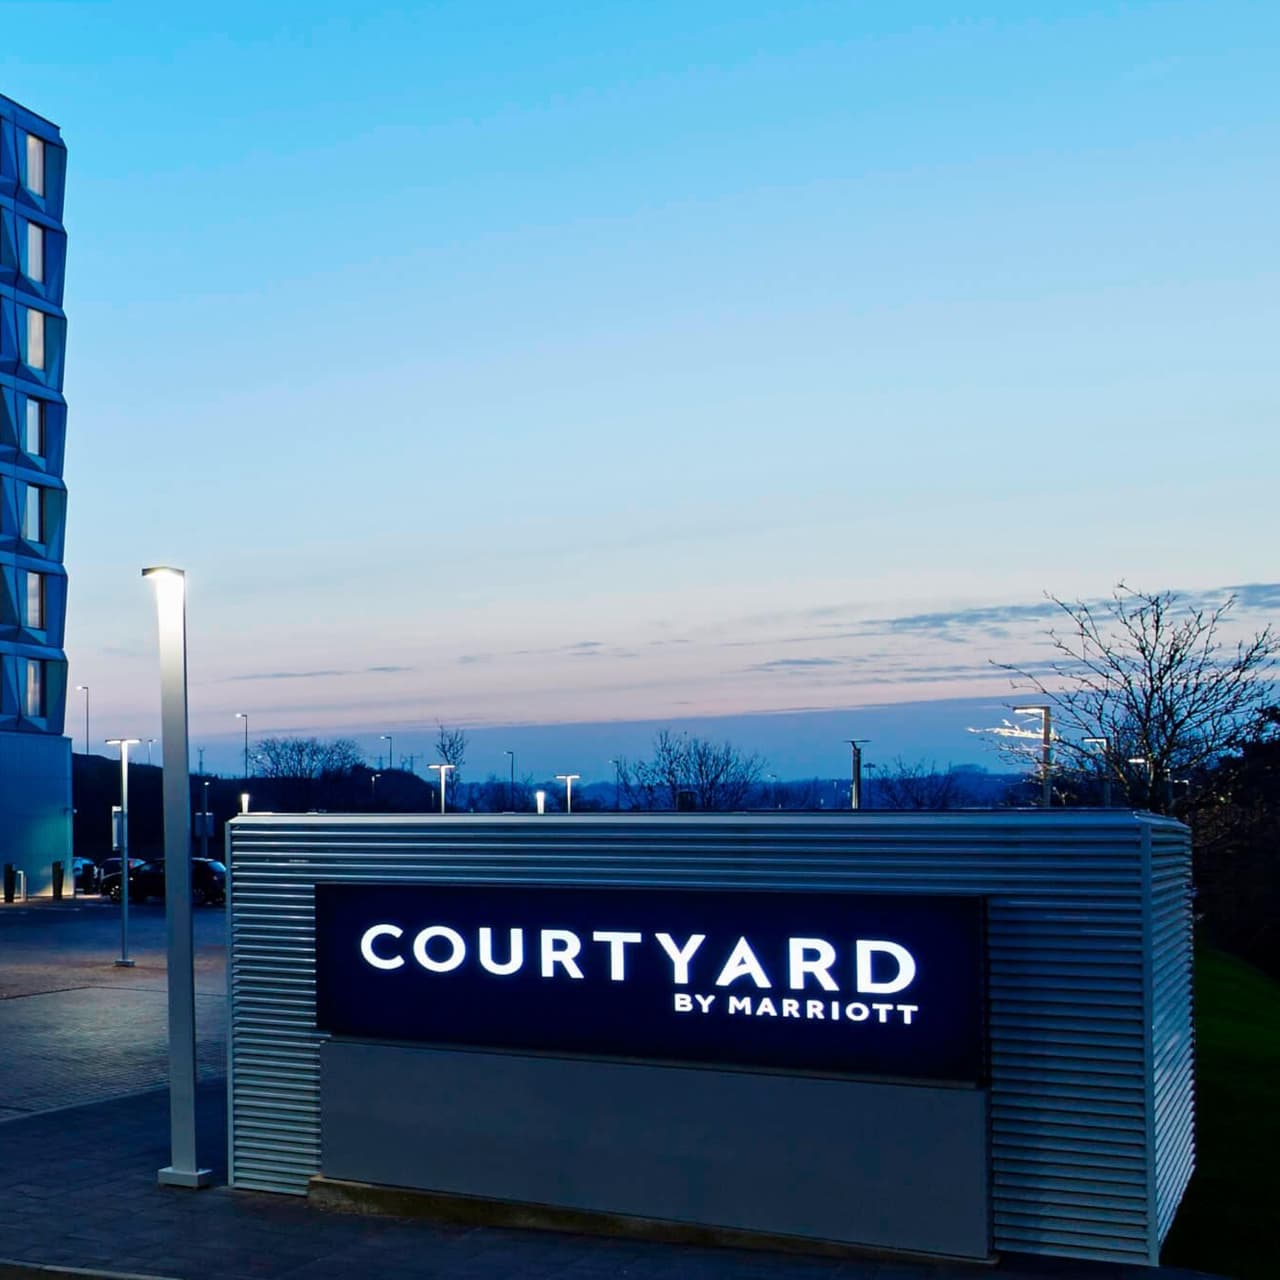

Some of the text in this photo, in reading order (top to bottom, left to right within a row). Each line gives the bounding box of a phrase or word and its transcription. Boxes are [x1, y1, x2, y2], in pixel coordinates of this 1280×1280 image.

[360, 923, 916, 994] COURTYARD
[674, 993, 919, 1025] BY MARRIOTT
